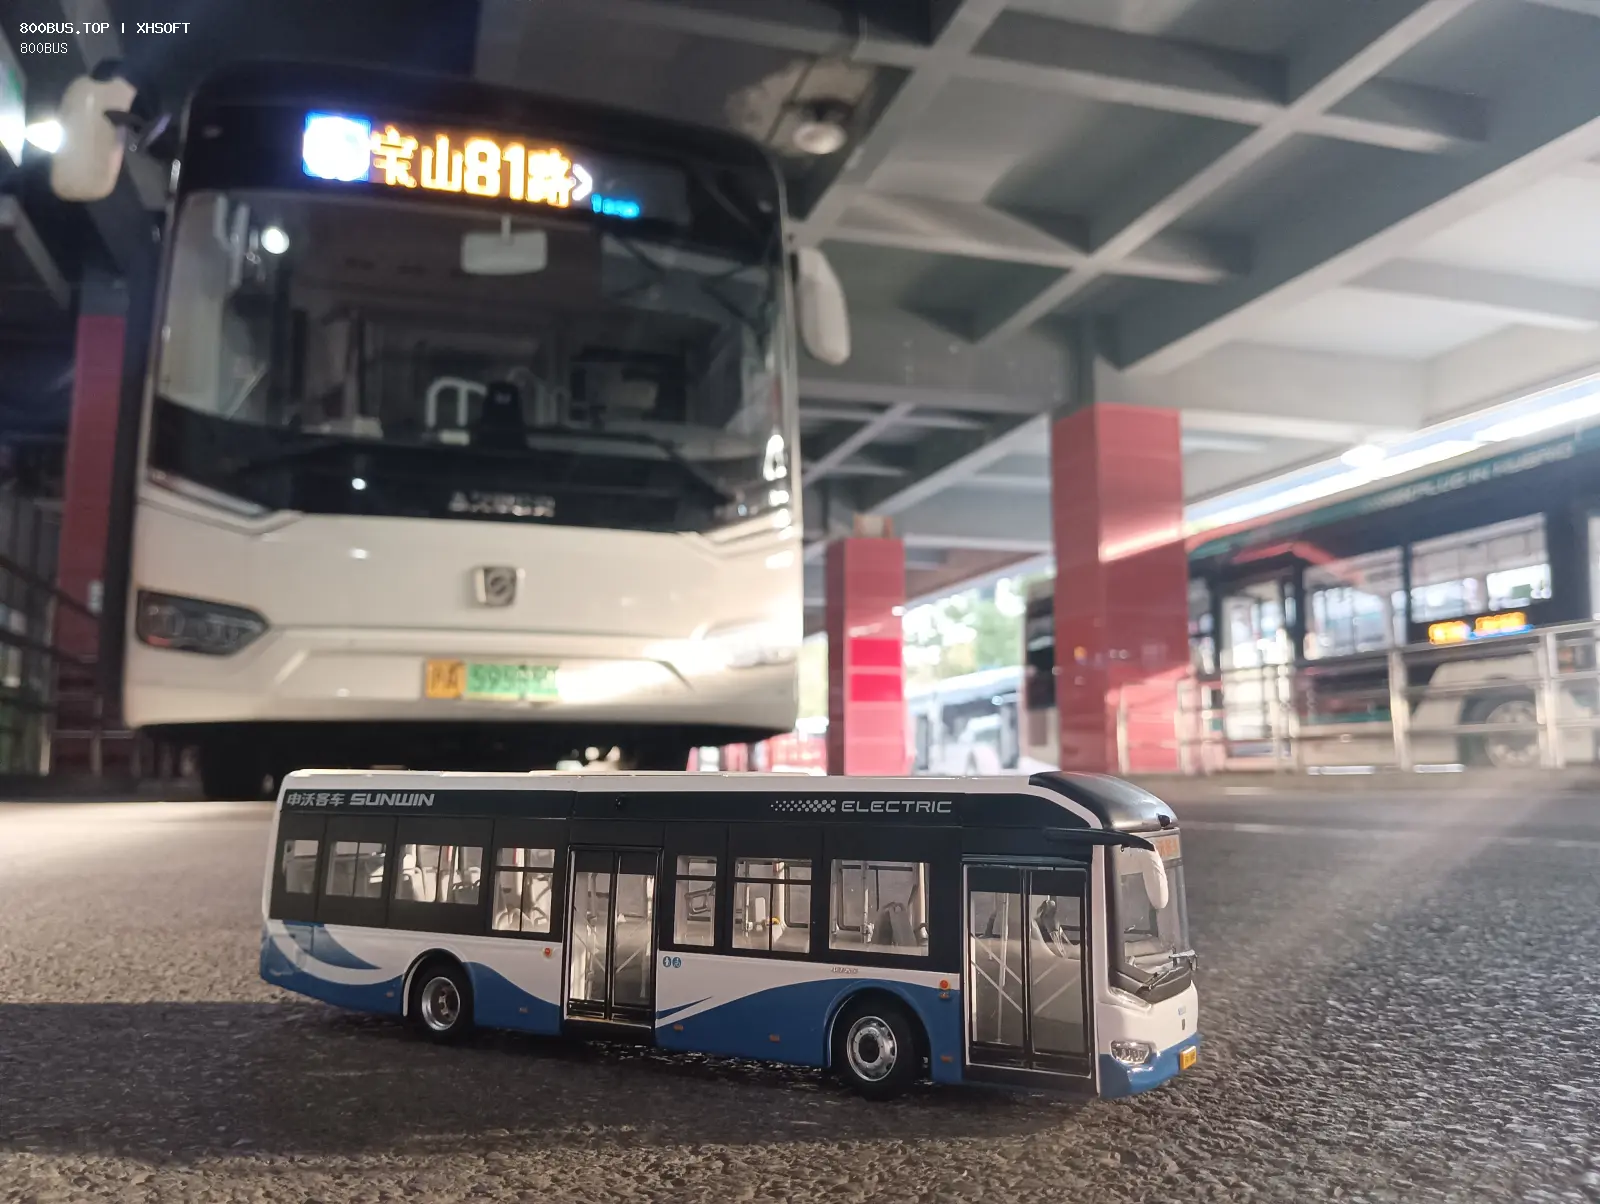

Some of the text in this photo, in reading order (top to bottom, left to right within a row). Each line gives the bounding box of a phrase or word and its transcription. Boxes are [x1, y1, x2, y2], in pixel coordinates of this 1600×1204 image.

[286, 792, 435, 807] 申沃客车 SUNWIN
[841, 800, 953, 813] ELECTRIC
